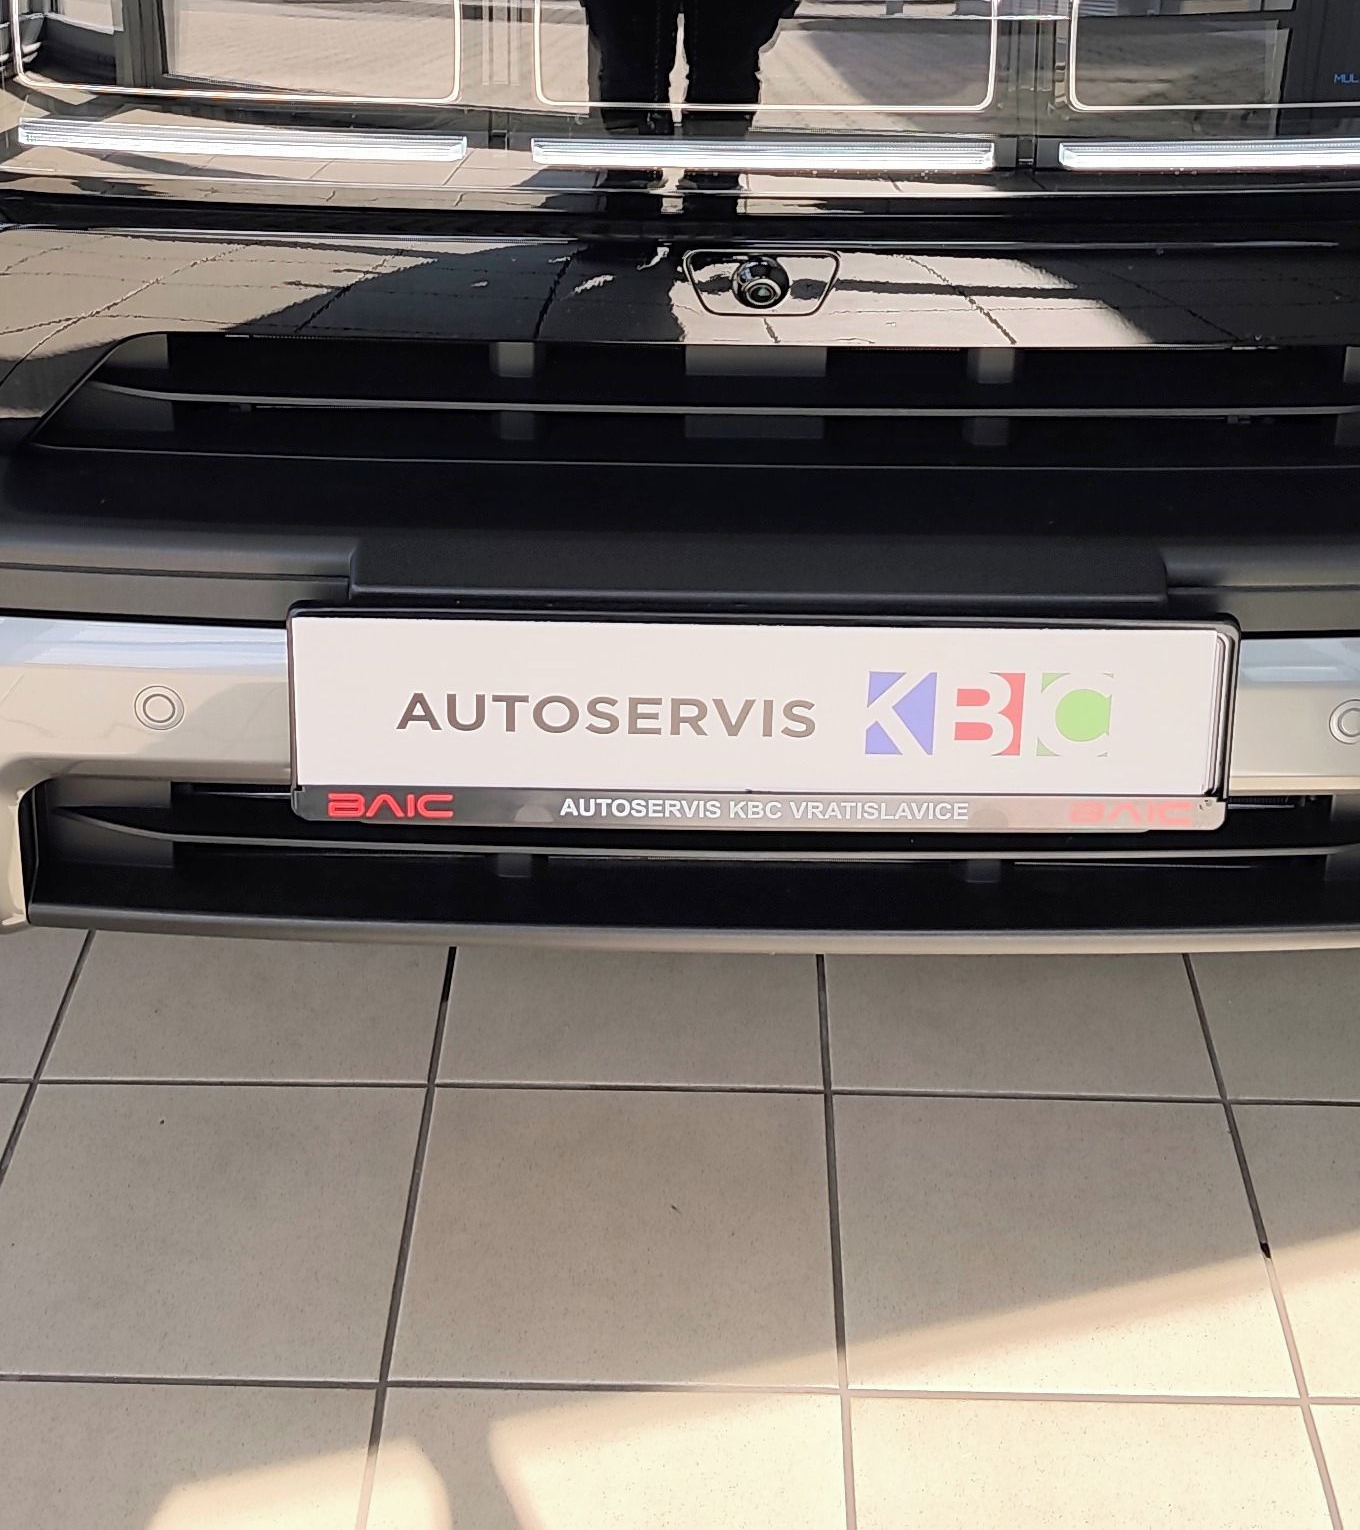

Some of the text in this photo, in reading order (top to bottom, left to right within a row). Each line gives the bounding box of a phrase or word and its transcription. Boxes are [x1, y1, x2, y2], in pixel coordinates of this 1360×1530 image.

[396, 670, 1115, 758] AUTOSERVIS KBC
[327, 792, 1195, 827] BAIC AUTOSERVIS KBC VRATISLAVICE BAIC
